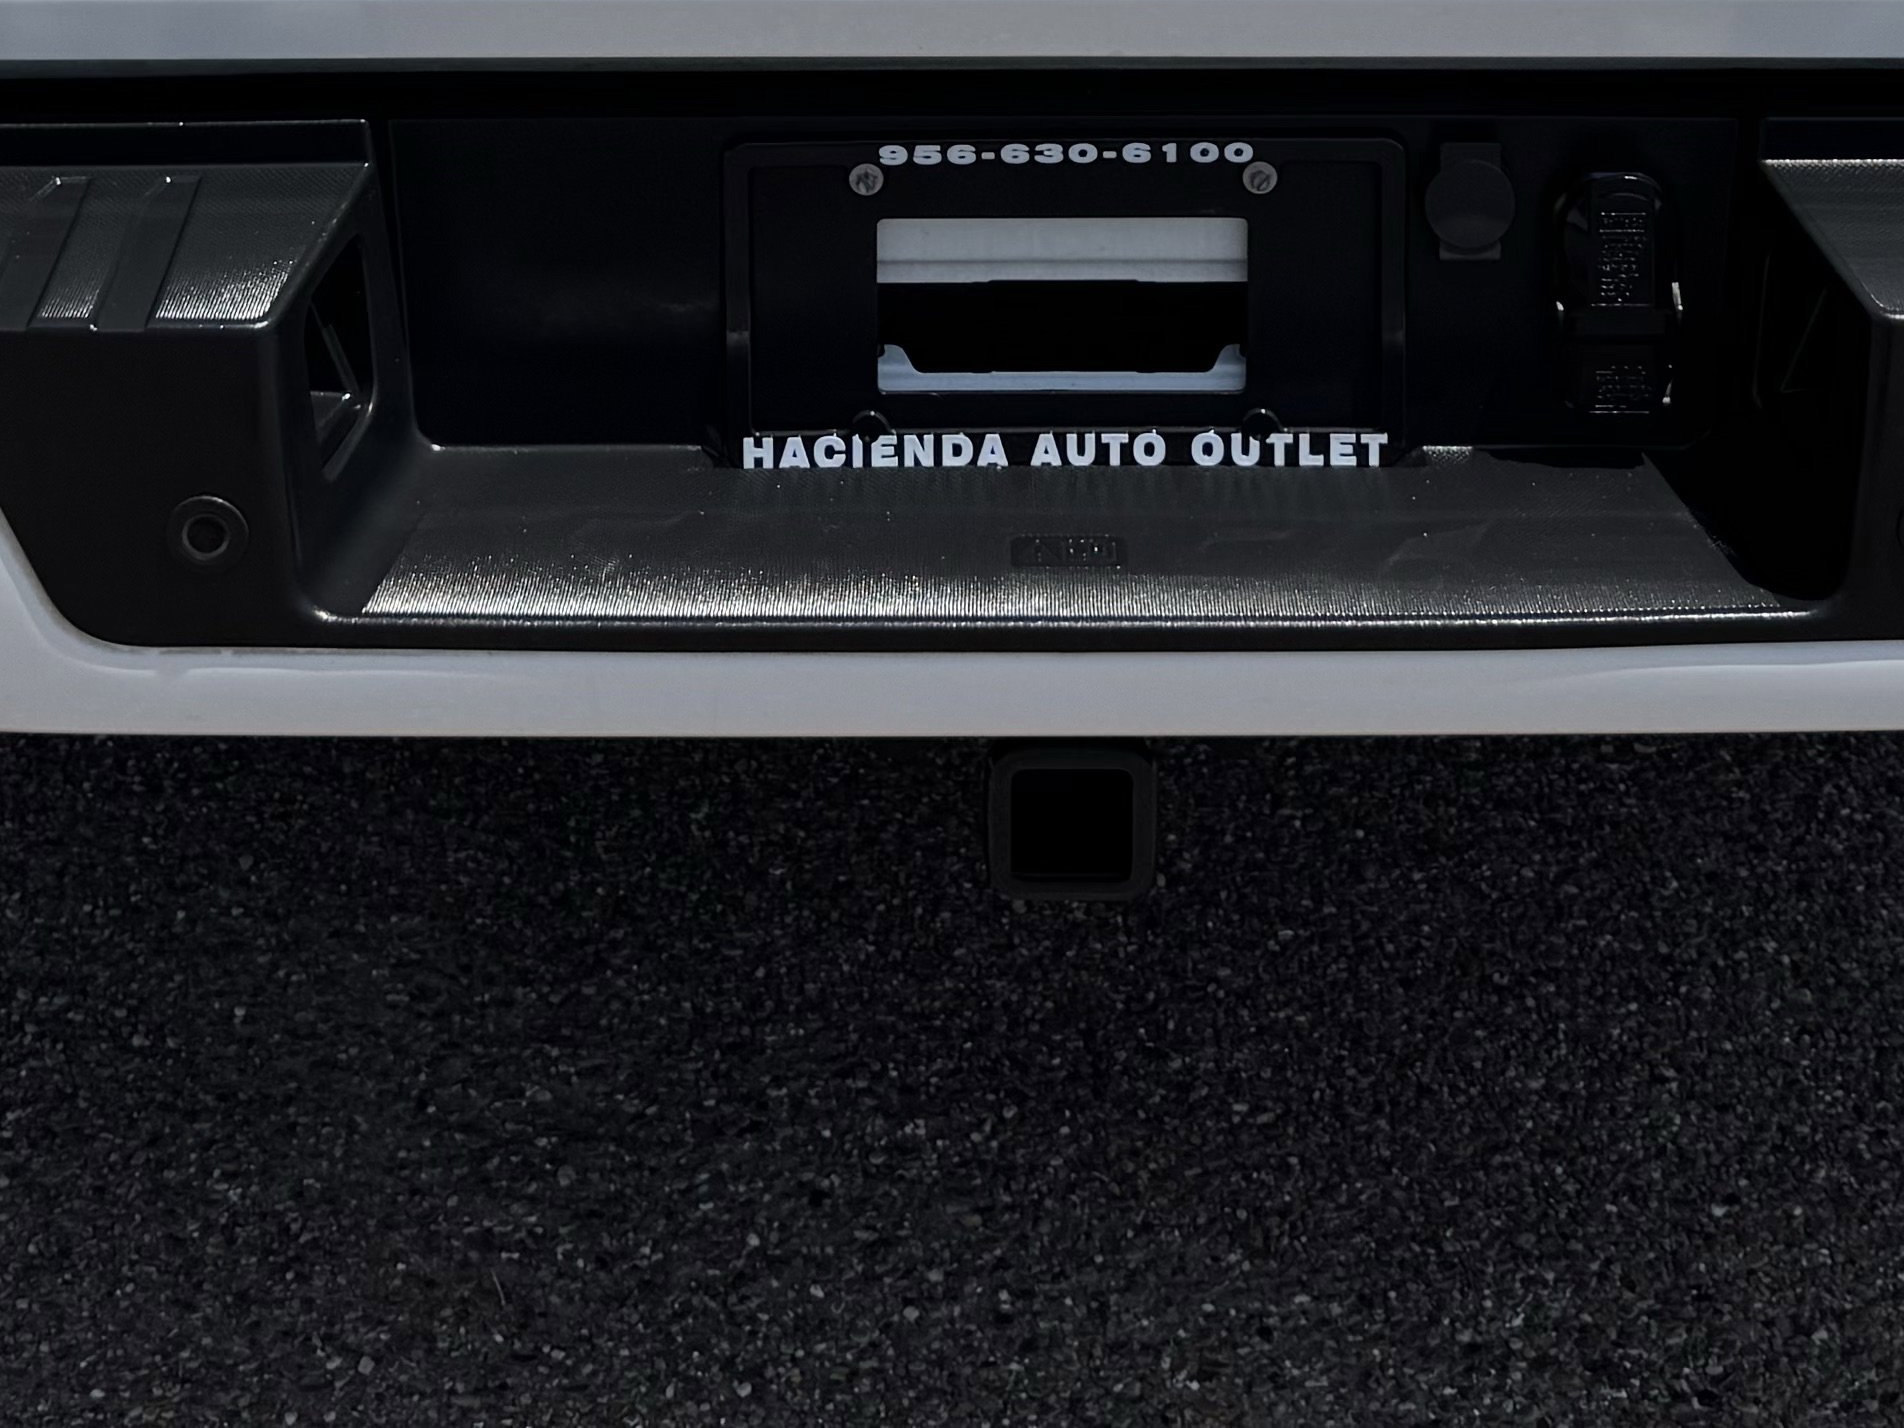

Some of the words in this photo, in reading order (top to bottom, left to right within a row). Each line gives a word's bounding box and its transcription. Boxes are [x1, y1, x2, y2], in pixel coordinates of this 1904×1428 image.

[878, 142, 1254, 166] 956-630-6100
[742, 432, 1009, 470] HACIENDA
[1030, 429, 1166, 467] AUTO
[1191, 430, 1388, 468] OUTLET
